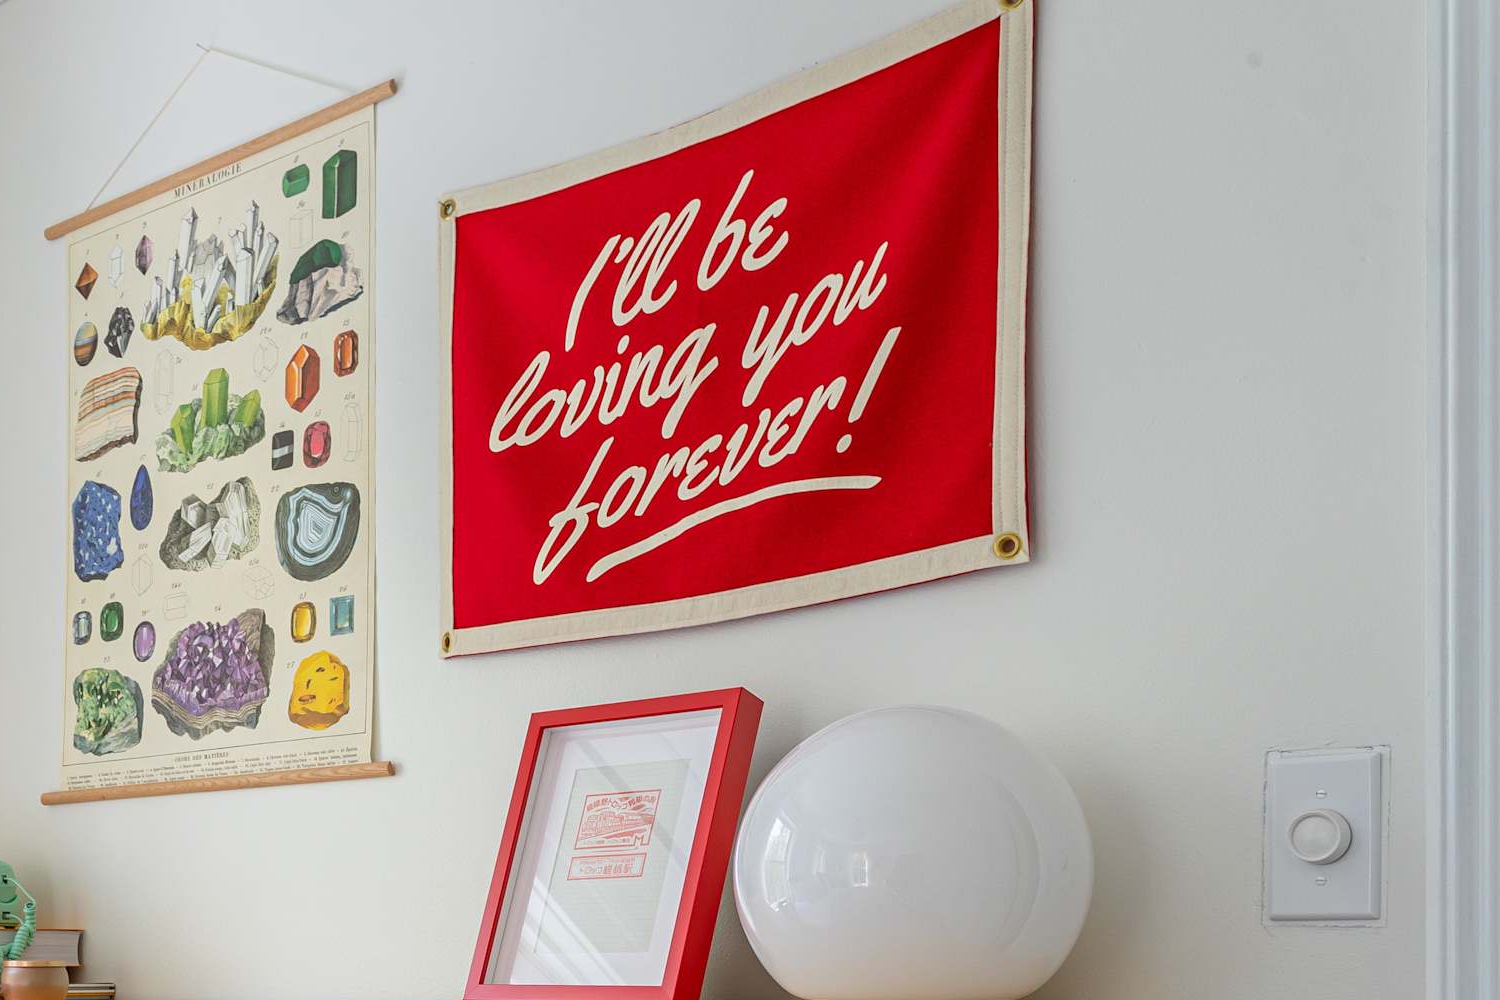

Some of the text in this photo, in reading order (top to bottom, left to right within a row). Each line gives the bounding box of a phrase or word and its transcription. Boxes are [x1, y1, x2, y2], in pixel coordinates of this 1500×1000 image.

[488, 241, 889, 453] loving you
[565, 169, 788, 352] I'll be
[532, 326, 902, 585] forever!
